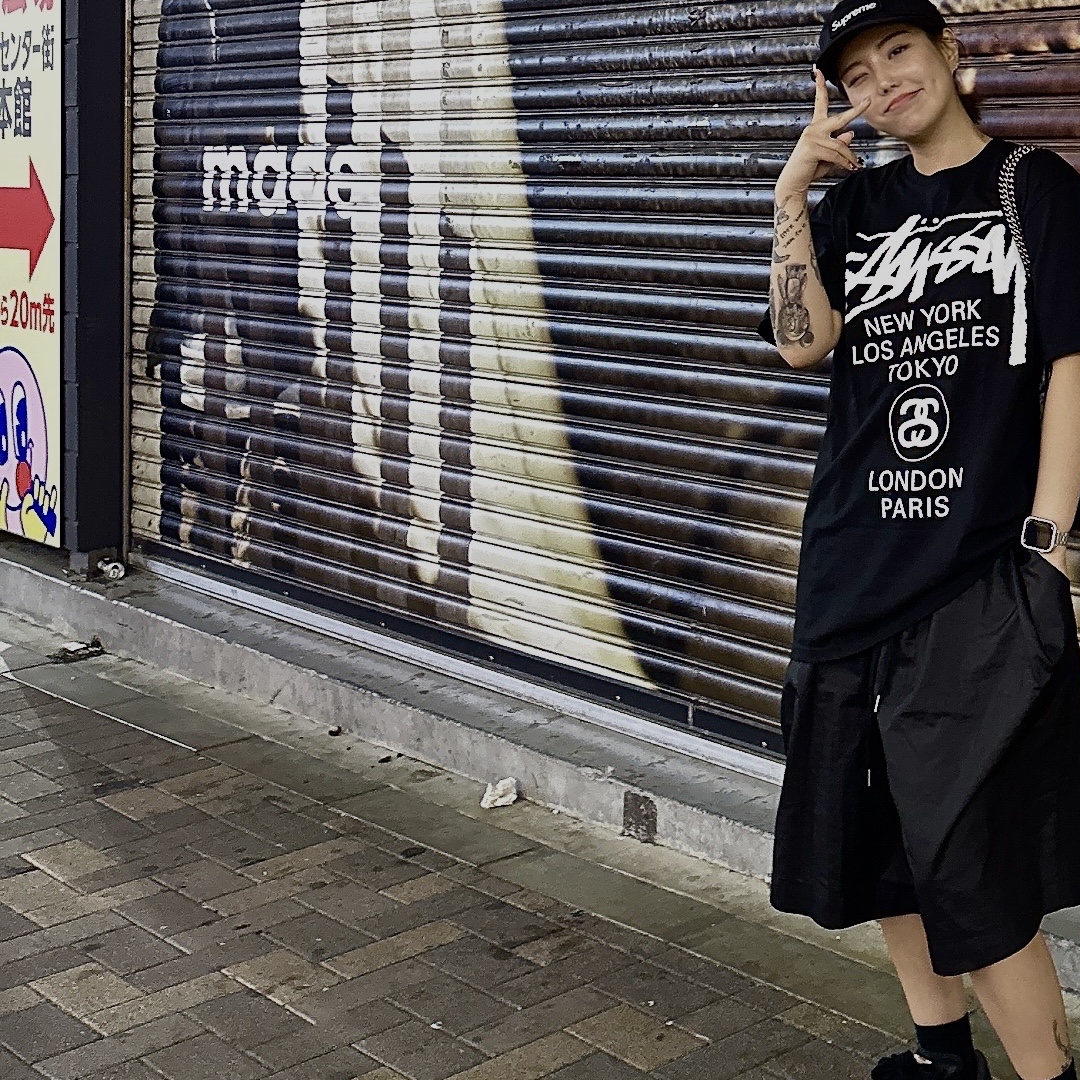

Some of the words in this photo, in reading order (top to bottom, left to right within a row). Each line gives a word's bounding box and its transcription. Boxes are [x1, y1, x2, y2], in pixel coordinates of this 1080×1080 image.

[832, 2, 877, 31] Supreme
[863, 310, 915, 338] NEW
[920, 298, 982, 327] YORK
[852, 340, 894, 366] LOS
[900, 325, 1000, 358] ANGELES
[888, 355, 959, 383] TOKYO
[868, 467, 964, 492] LONDON
[881, 495, 950, 519] PARIS
